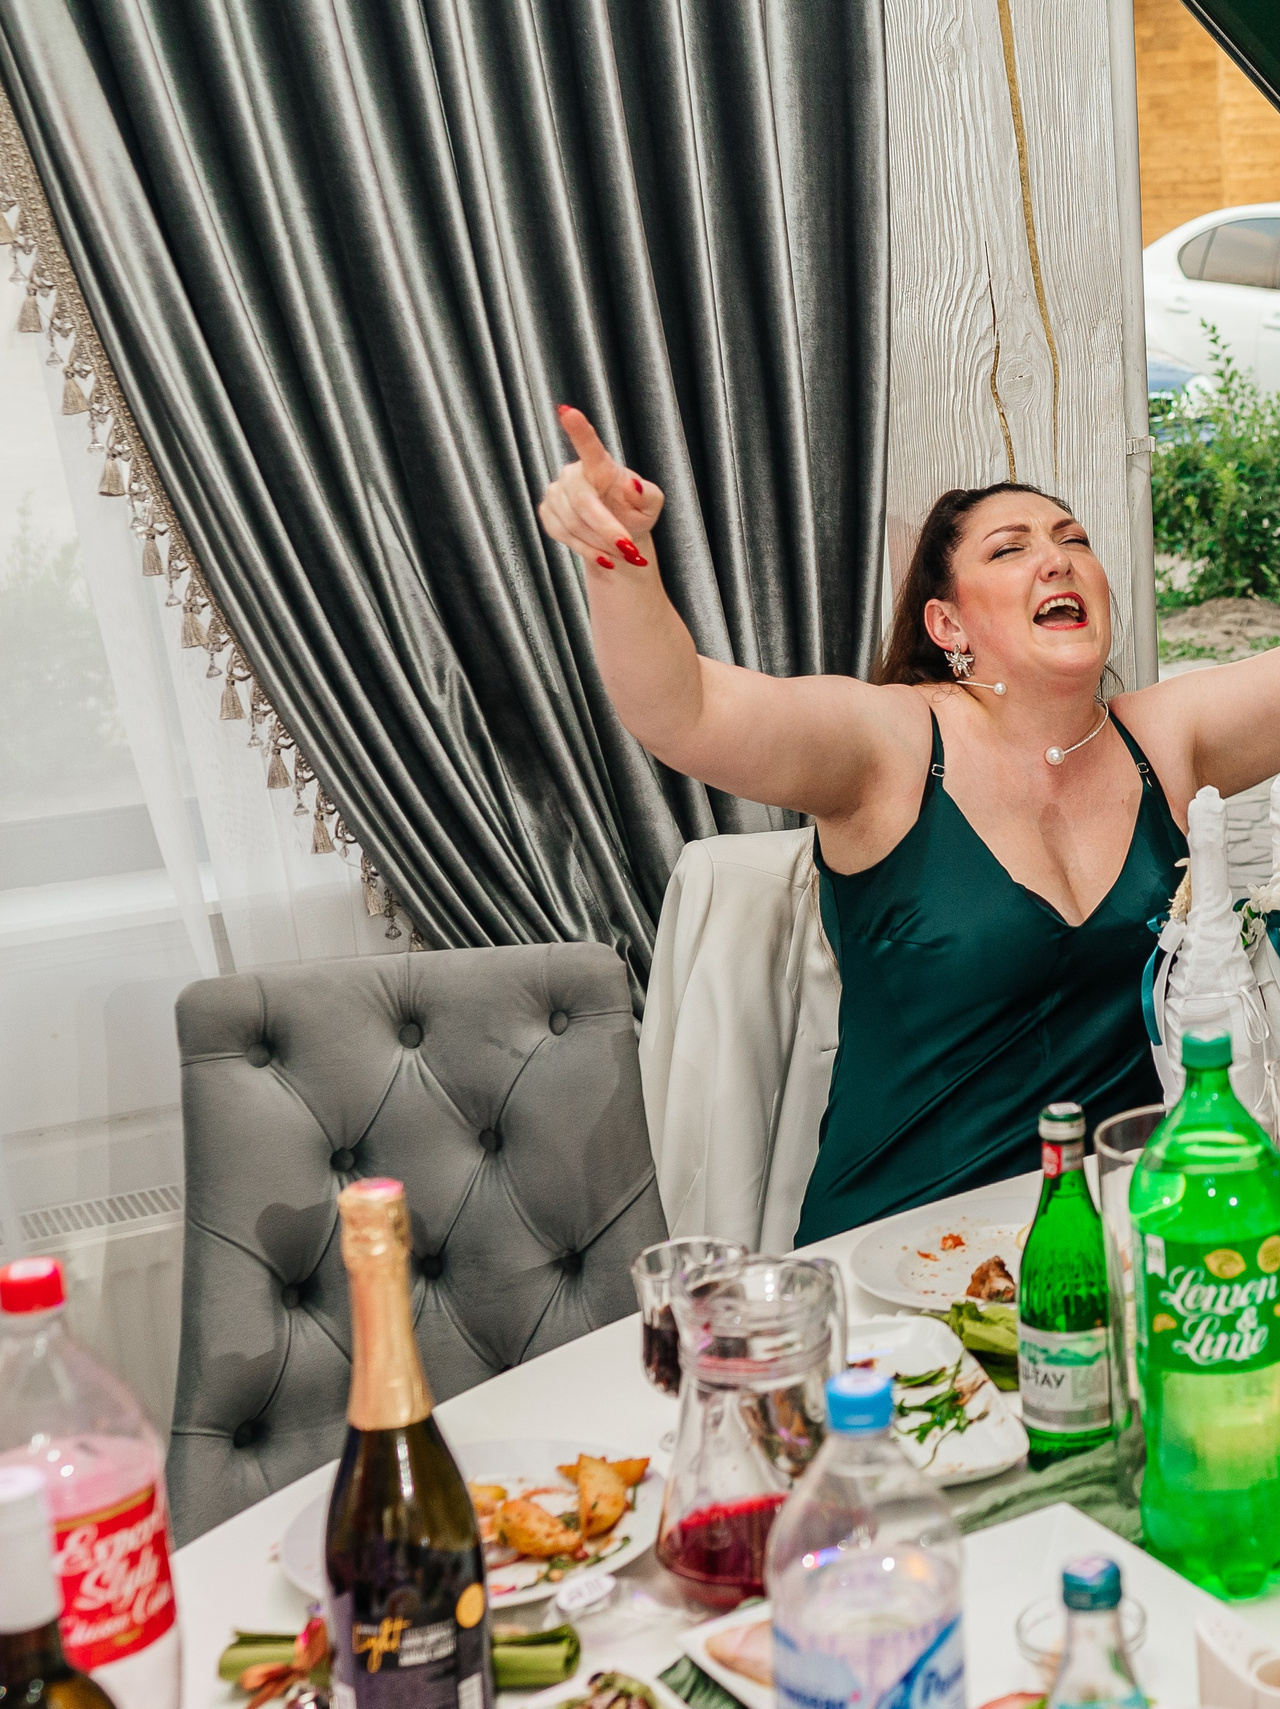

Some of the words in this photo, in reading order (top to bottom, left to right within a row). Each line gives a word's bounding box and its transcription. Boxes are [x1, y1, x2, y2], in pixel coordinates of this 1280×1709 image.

[1158, 1265, 1279, 1319] Lemon
[1171, 1314, 1270, 1366] Lime
[1235, 1305, 1259, 1333] &
